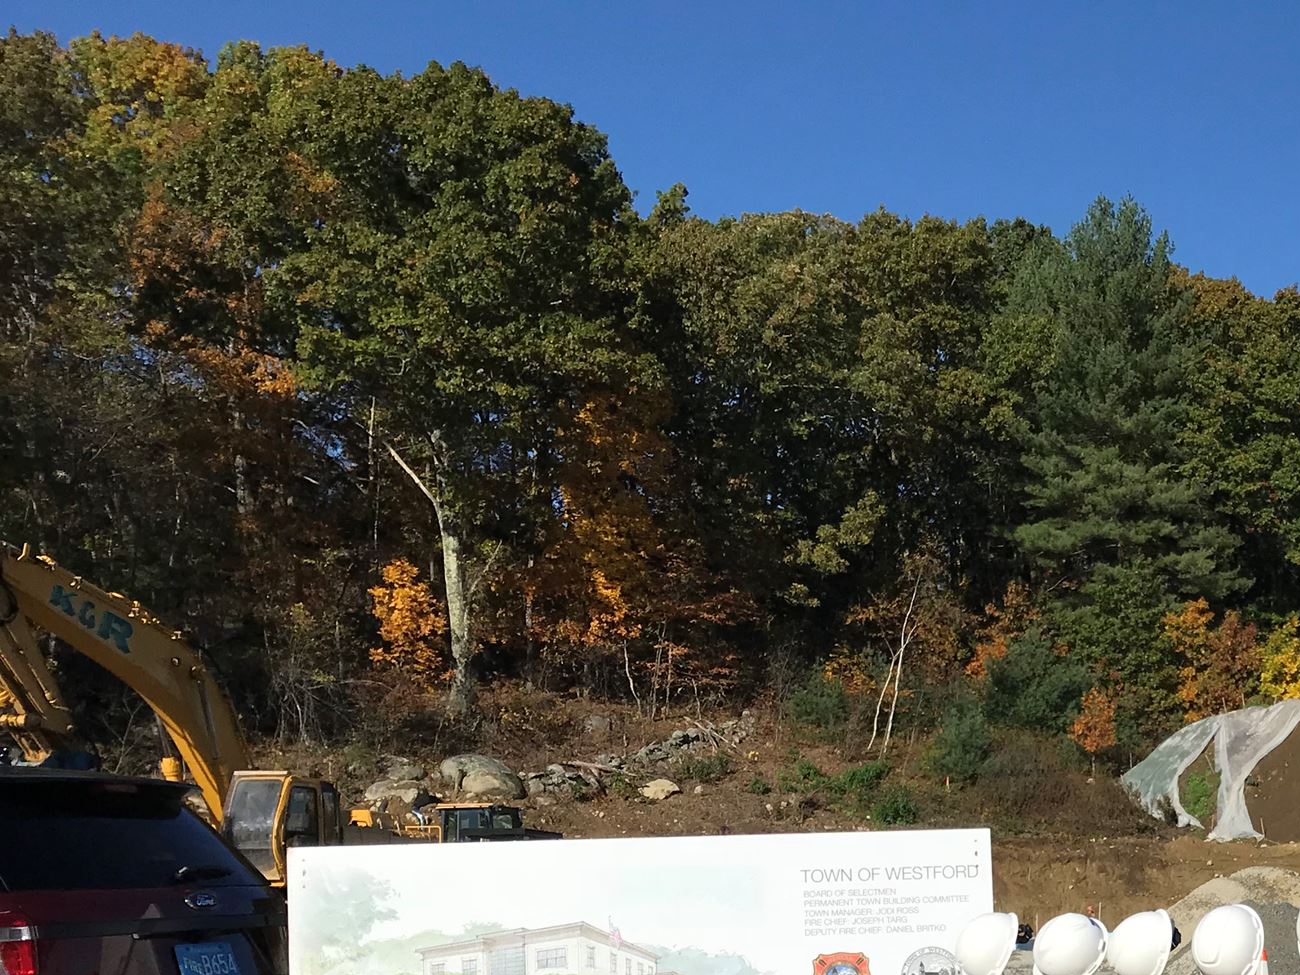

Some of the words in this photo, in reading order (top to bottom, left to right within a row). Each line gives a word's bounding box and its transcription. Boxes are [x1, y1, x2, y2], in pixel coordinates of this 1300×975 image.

[800, 868, 853, 883] TOWN
[857, 867, 881, 882] OF
[885, 864, 979, 881] WESTFORD
[803, 889, 832, 898] BOARD
[834, 889, 846, 897] OF
[847, 888, 897, 897] SELECTMEN
[804, 898, 854, 908] PERMANENT
[856, 897, 881, 906] TOWN
[883, 896, 921, 905] BUILDING
[922, 894, 969, 904] COMMITTEE
[804, 909, 830, 918] TOWN
[804, 918, 822, 926] FIRE
[852, 916, 885, 925] JOSEPH
[804, 927, 837, 937] DEPUTY
[838, 926, 857, 935] FIRE
[886, 924, 915, 933] DANIEL
